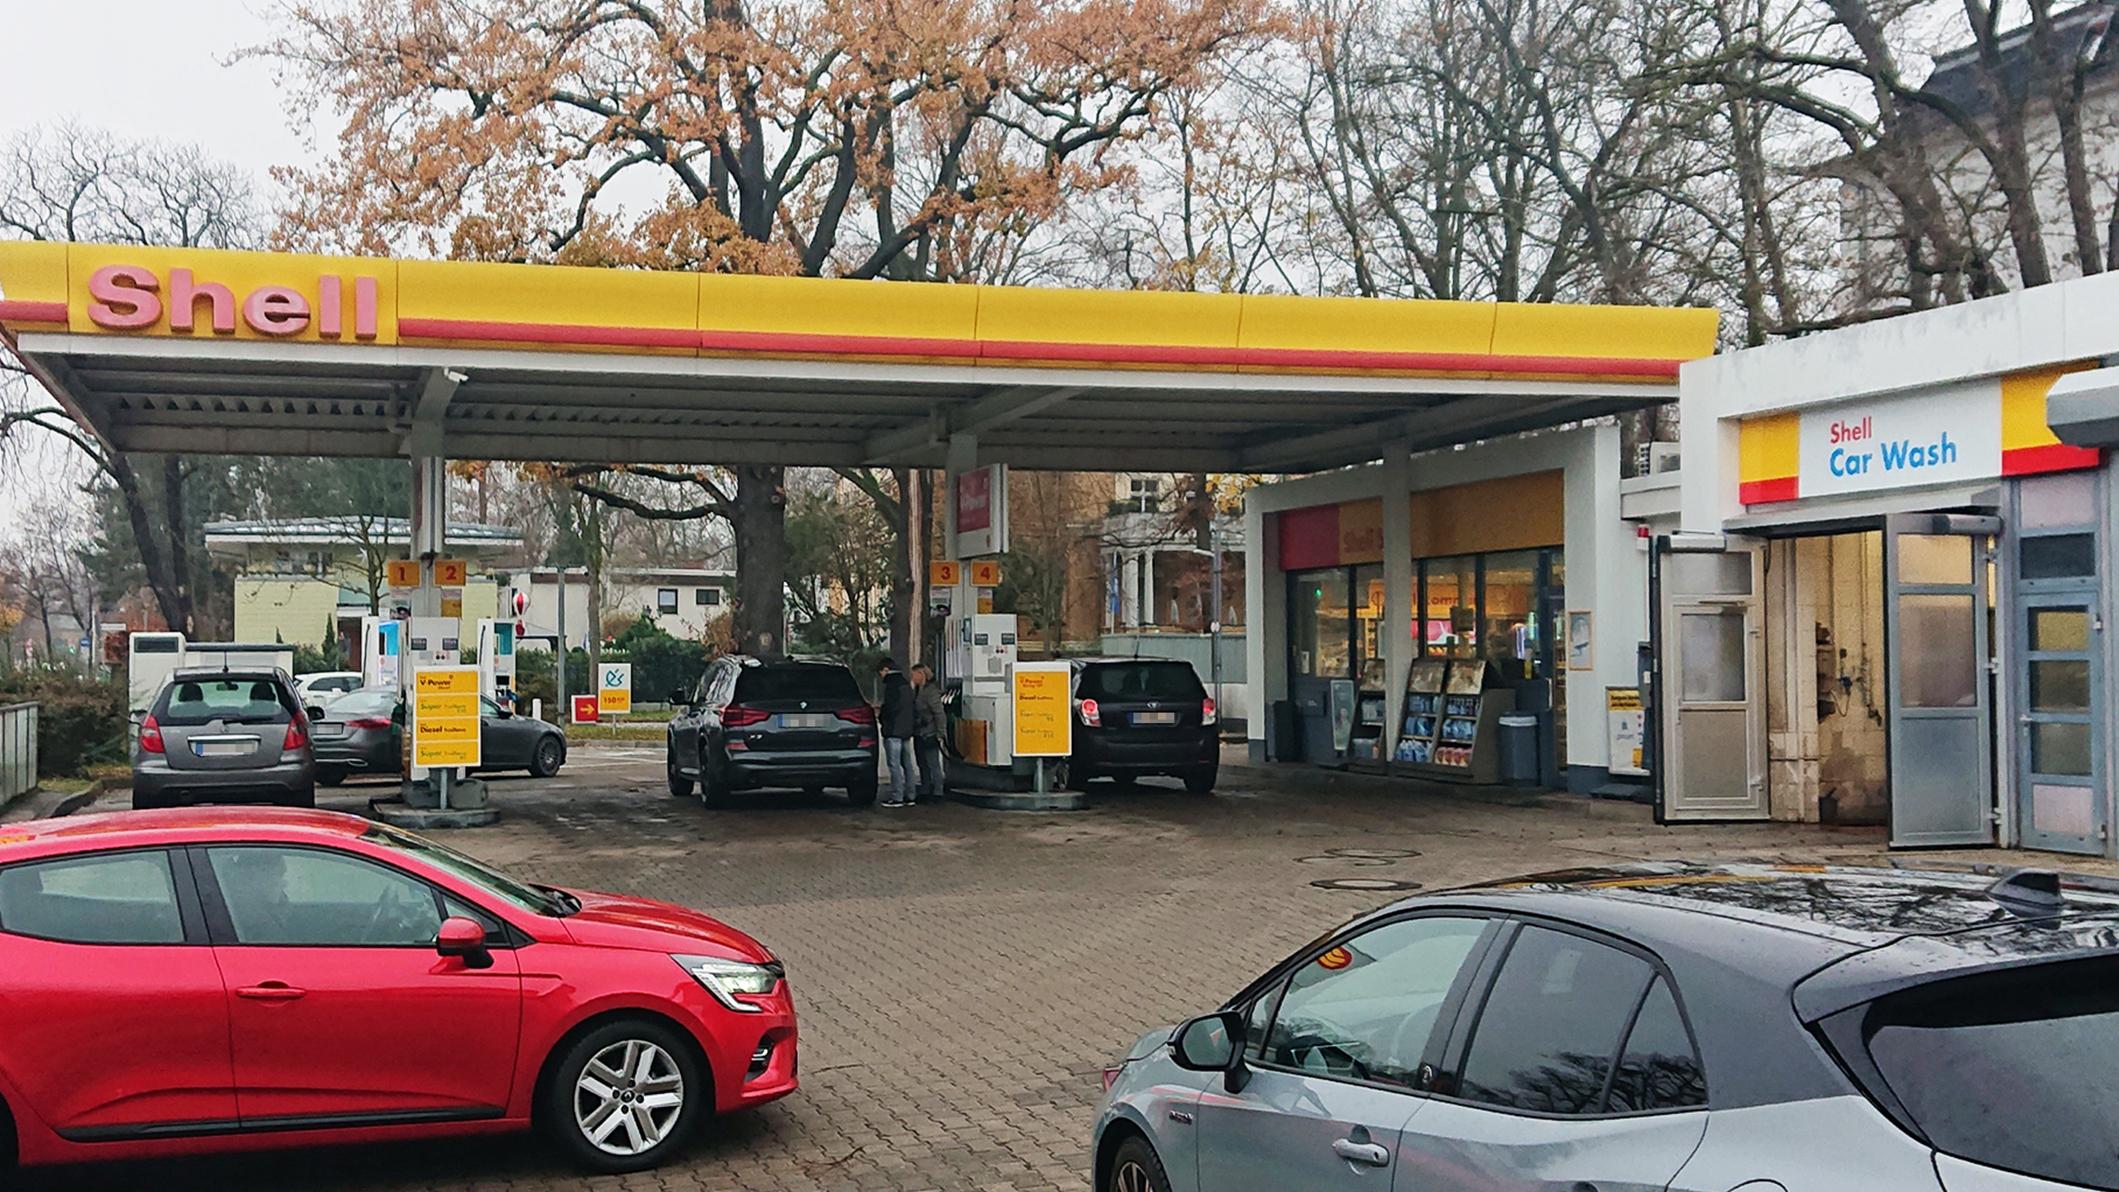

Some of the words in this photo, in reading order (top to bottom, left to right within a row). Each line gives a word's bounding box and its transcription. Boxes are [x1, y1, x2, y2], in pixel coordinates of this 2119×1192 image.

[88, 264, 377, 341] Shell
[1830, 416, 1872, 444] Shell
[1830, 447, 1873, 477] Car
[1881, 431, 1957, 471] Wash
[399, 566, 405, 581] 1
[446, 565, 457, 580] 2
[941, 566, 951, 580] 3
[980, 566, 991, 580] 4
[604, 696, 617, 704] 150
